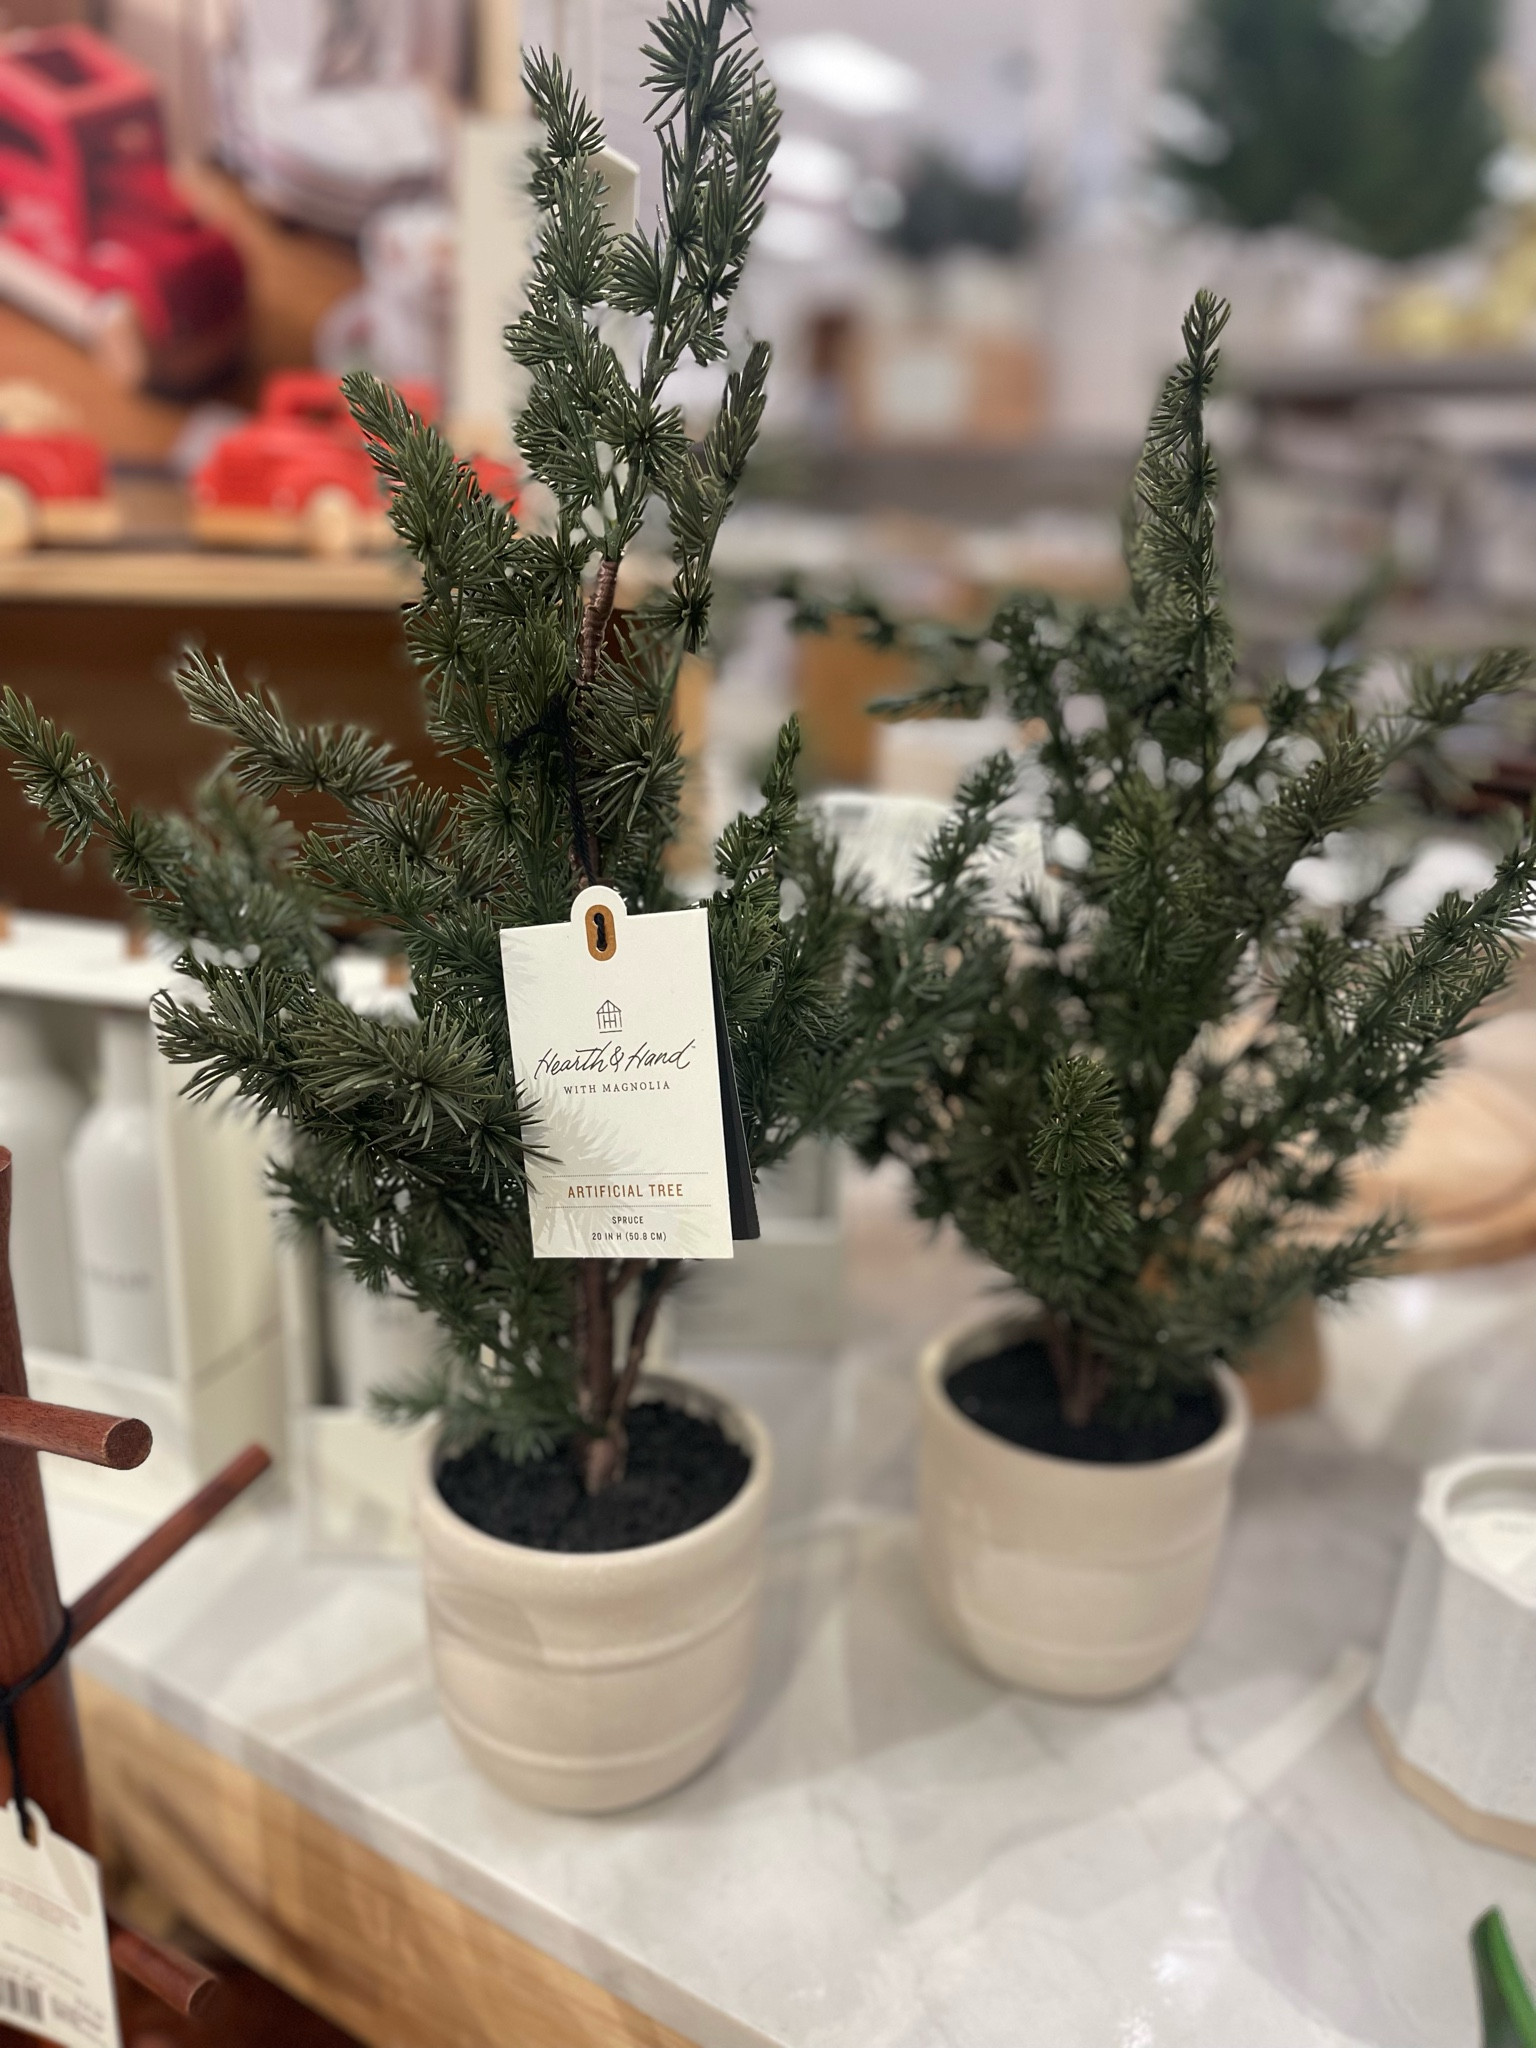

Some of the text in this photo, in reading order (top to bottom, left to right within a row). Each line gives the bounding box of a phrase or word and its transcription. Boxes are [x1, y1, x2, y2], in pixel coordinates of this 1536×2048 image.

[534, 1041, 612, 1079] Hearth
[610, 1046, 624, 1072] &
[564, 1081, 670, 1094] WITH MAGNOLIA
[568, 1184, 683, 1198] ARTIFICIAL TREE
[612, 1216, 644, 1224] SPRUCE
[592, 1232, 602, 1241] 20
[616, 1232, 622, 1240] H
[625, 1232, 648, 1242] (50.8
[650, 1232, 667, 1241] CM)
